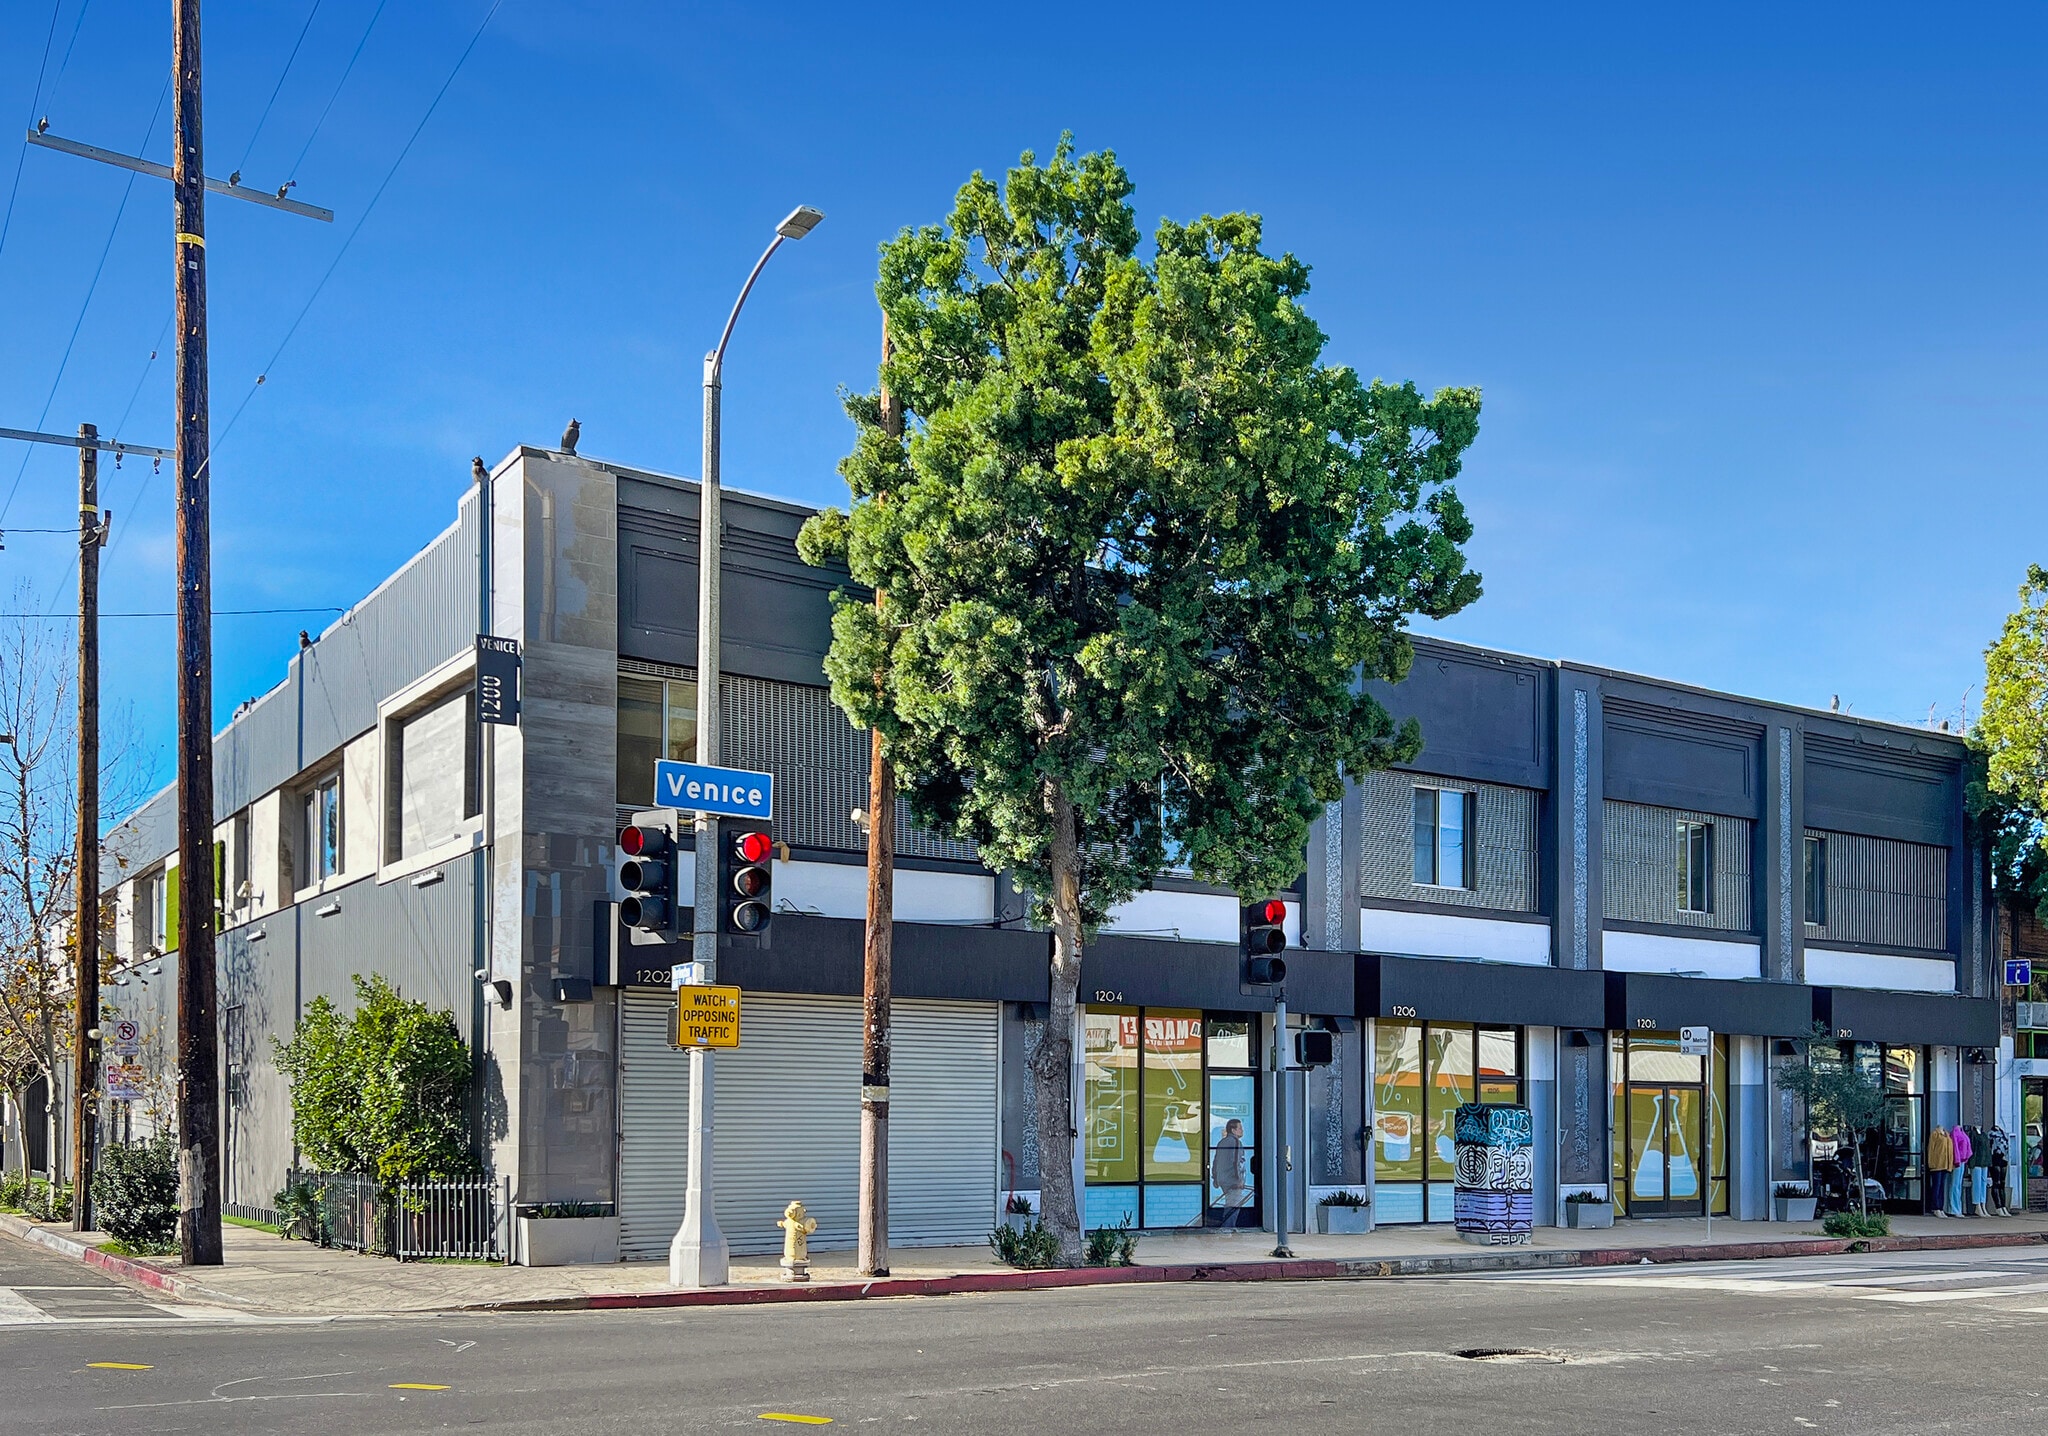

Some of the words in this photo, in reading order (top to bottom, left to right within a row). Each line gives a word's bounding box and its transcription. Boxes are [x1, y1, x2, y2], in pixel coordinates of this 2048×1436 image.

[480, 638, 515, 653] VENICE
[481, 675, 501, 719] 1200
[666, 773, 762, 806] Venice
[635, 969, 672, 983] 1202
[694, 994, 727, 1007] WATCH
[1095, 990, 1123, 1003] 1204
[683, 1009, 736, 1023] OPPOSING
[1392, 1005, 1416, 1017] 1206
[1637, 1018, 1657, 1029] 1208
[688, 1025, 730, 1038] TRAFFIC
[1836, 1028, 1853, 1038] 1210
[1097, 1105, 1118, 1148] LAB
